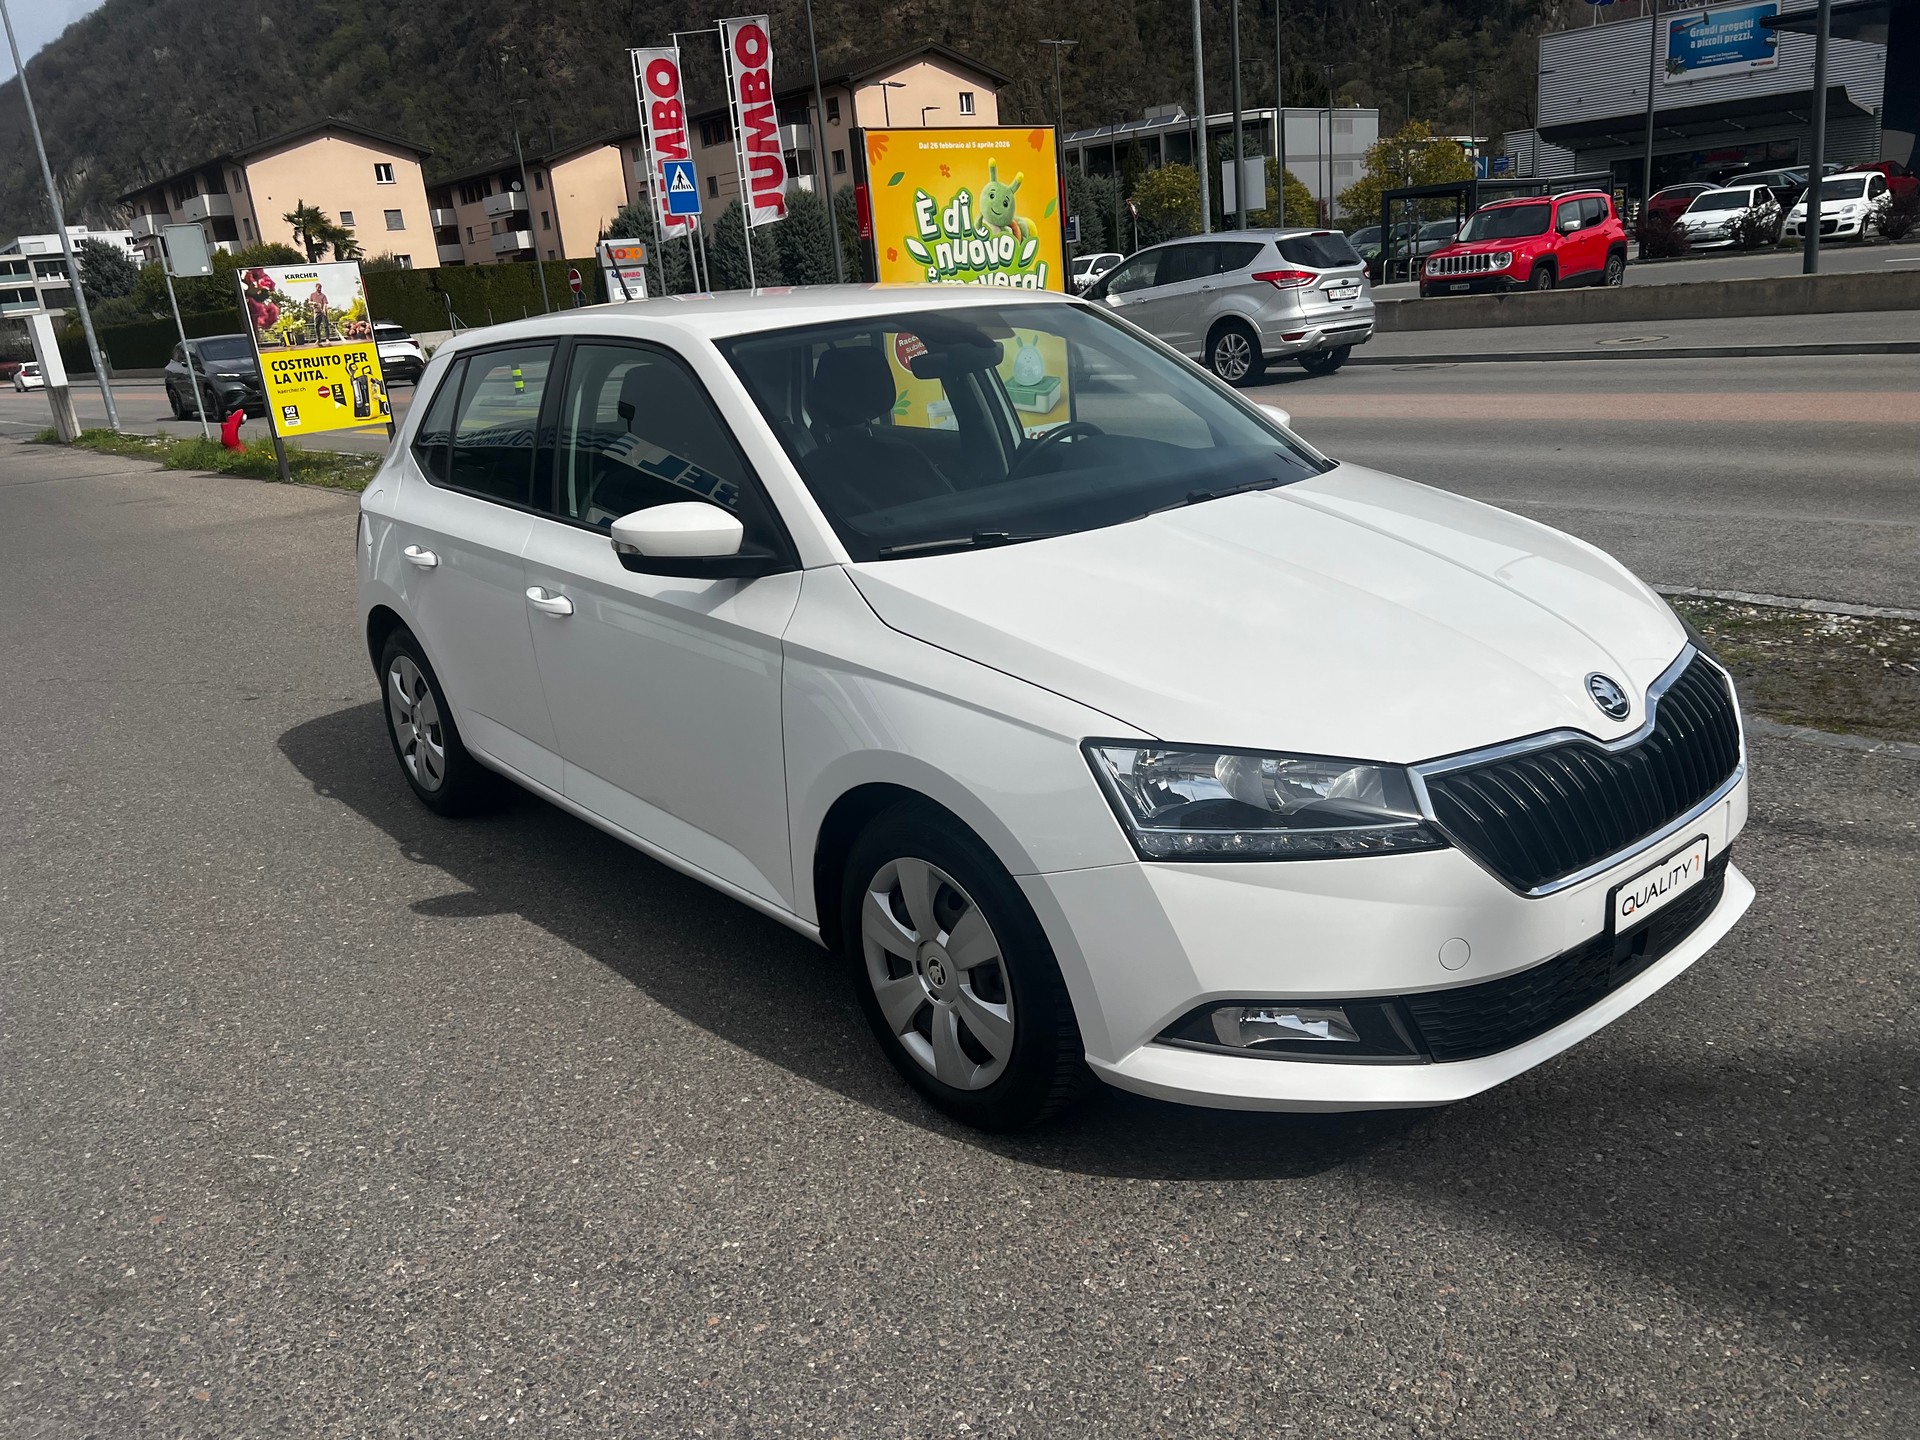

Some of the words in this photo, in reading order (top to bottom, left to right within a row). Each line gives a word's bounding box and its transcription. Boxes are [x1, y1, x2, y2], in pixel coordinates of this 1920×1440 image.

[1689, 25, 1718, 38] Grandi
[1719, 19, 1754, 32] progetti
[1697, 36, 1723, 48] piccoli
[1724, 31, 1753, 44] prezzi.
[735, 24, 788, 218] JUMBO
[646, 58, 695, 230] JMBO
[939, 141, 965, 149] febbraio
[977, 141, 994, 149] aprile
[915, 190, 938, 235] È
[943, 191, 971, 234] di
[935, 234, 1015, 270] nuovo
[621, 271, 641, 279] UMBO
[271, 355, 341, 372] COSTRUITO
[344, 352, 368, 364] PER
[274, 373, 292, 384] LA
[294, 370, 328, 383] VITA.
[277, 387, 306, 395] kaercher.ch
[334, 385, 341, 393] 5
[284, 406, 296, 414] 60
